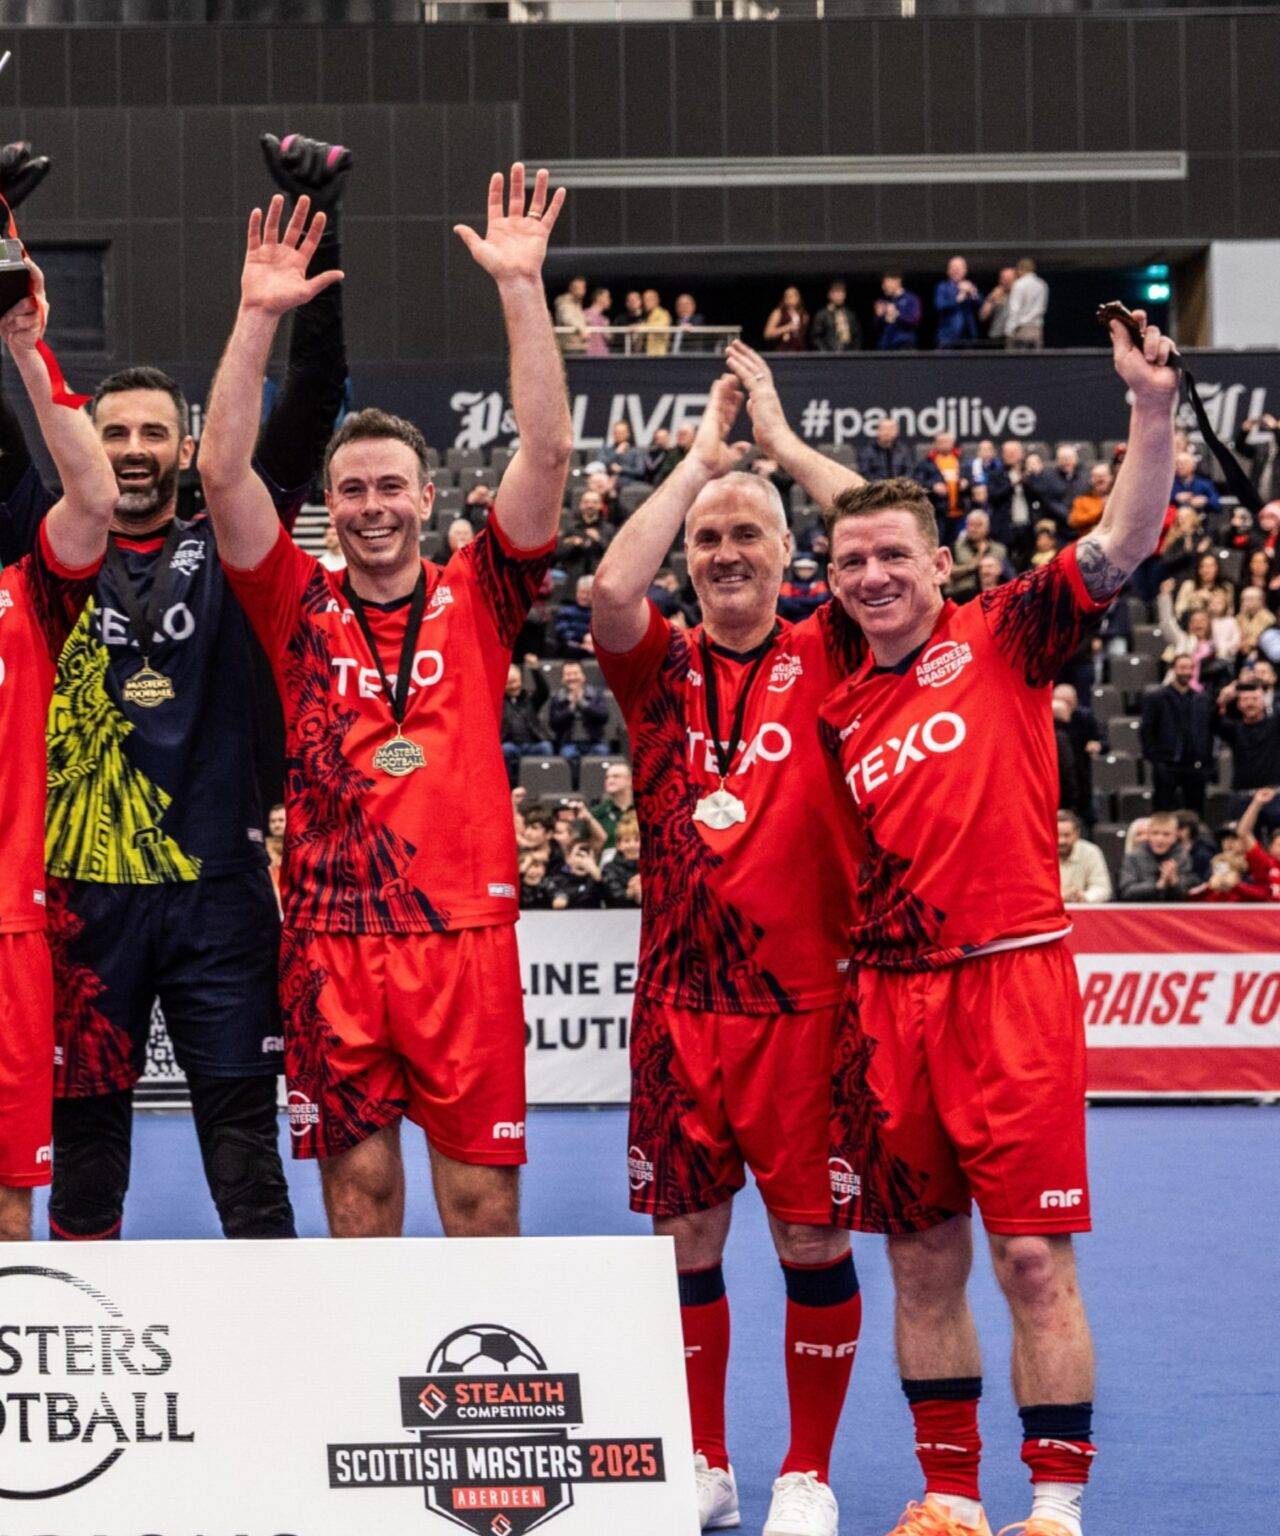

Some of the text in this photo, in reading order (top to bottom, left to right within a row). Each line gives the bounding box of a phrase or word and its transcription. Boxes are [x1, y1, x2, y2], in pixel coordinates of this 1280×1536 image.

[801, 396, 1037, 447] #pandjlive
[916, 642, 971, 676] ABERDEEN
[917, 652, 973, 687] MASTERS
[845, 711, 967, 804] TEXO
[521, 962, 600, 995] INE
[1084, 971, 1216, 1025] RAISE
[455, 1382, 564, 1404] STEALTH
[457, 1405, 565, 1418] COMPETITIONS
[336, 1444, 656, 1482] SCOTTISH MASTERS 2025
[458, 1490, 541, 1505] ABERDEEN
